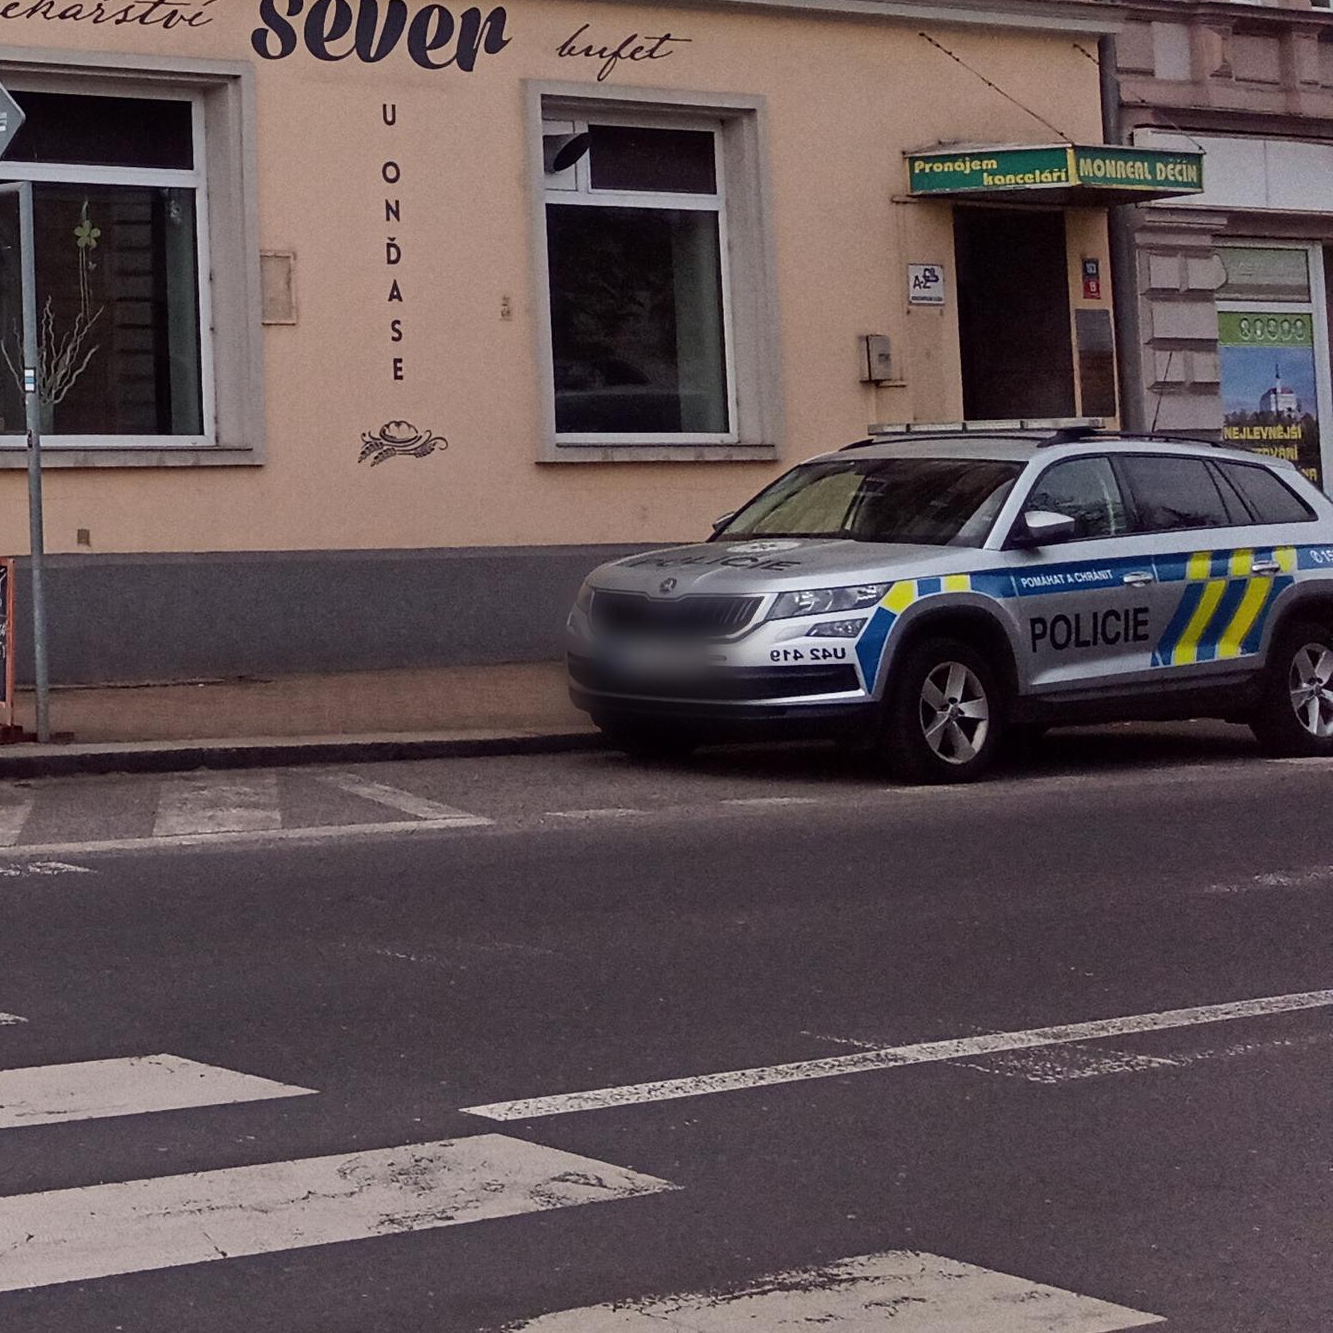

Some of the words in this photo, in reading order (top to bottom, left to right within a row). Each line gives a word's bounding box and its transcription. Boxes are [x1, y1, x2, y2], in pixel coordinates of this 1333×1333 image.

[554, 23, 695, 84] bufet
[381, 102, 398, 127] U
[914, 156, 998, 175] Pronájem
[982, 167, 1068, 187] kanceláří
[1155, 158, 1198, 183] DĚČÍN
[381, 160, 405, 382] ONĎASE
[1020, 572, 1065, 589] POMÁHAT
[1065, 573, 1074, 584] A
[1074, 568, 1114, 583] CHRÁNIT
[1029, 606, 1150, 654] POLICIE
